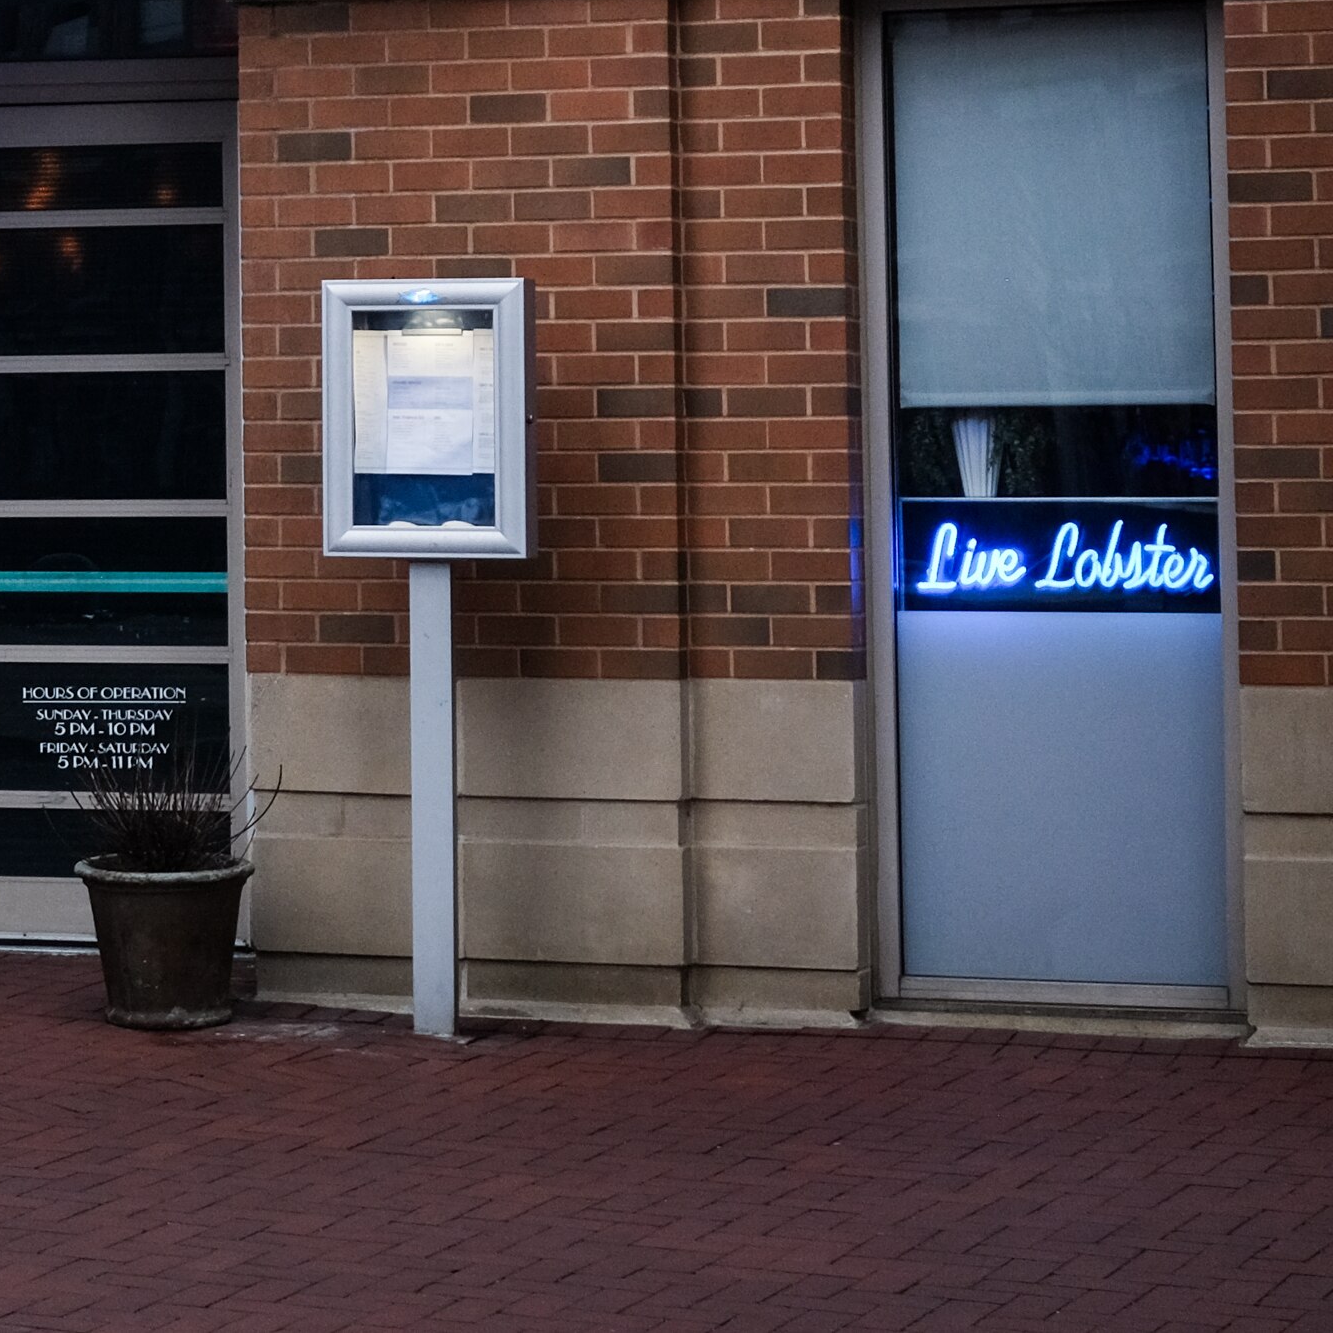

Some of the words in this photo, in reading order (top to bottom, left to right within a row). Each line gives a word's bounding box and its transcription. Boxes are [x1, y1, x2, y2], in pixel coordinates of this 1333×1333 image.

[917, 522, 1027, 590] Live
[1035, 519, 1214, 591] Lobster
[22, 686, 75, 700] HOURS
[77, 686, 98, 700] OF
[100, 686, 186, 700] OPERATION
[35, 709, 92, 721] SUNDAY
[101, 709, 173, 721] THURSDAY
[54, 722, 66, 736] 5
[70, 722, 95, 736] PM
[108, 722, 127, 736] 10
[130, 722, 156, 736] PM
[39, 742, 88, 754] FRIDAY
[97, 743, 170, 754] SATURDAY
[57, 756, 69, 769] 5
[73, 756, 99, 769] PM
[111, 756, 123, 769] 11
[128, 756, 154, 769] PM
